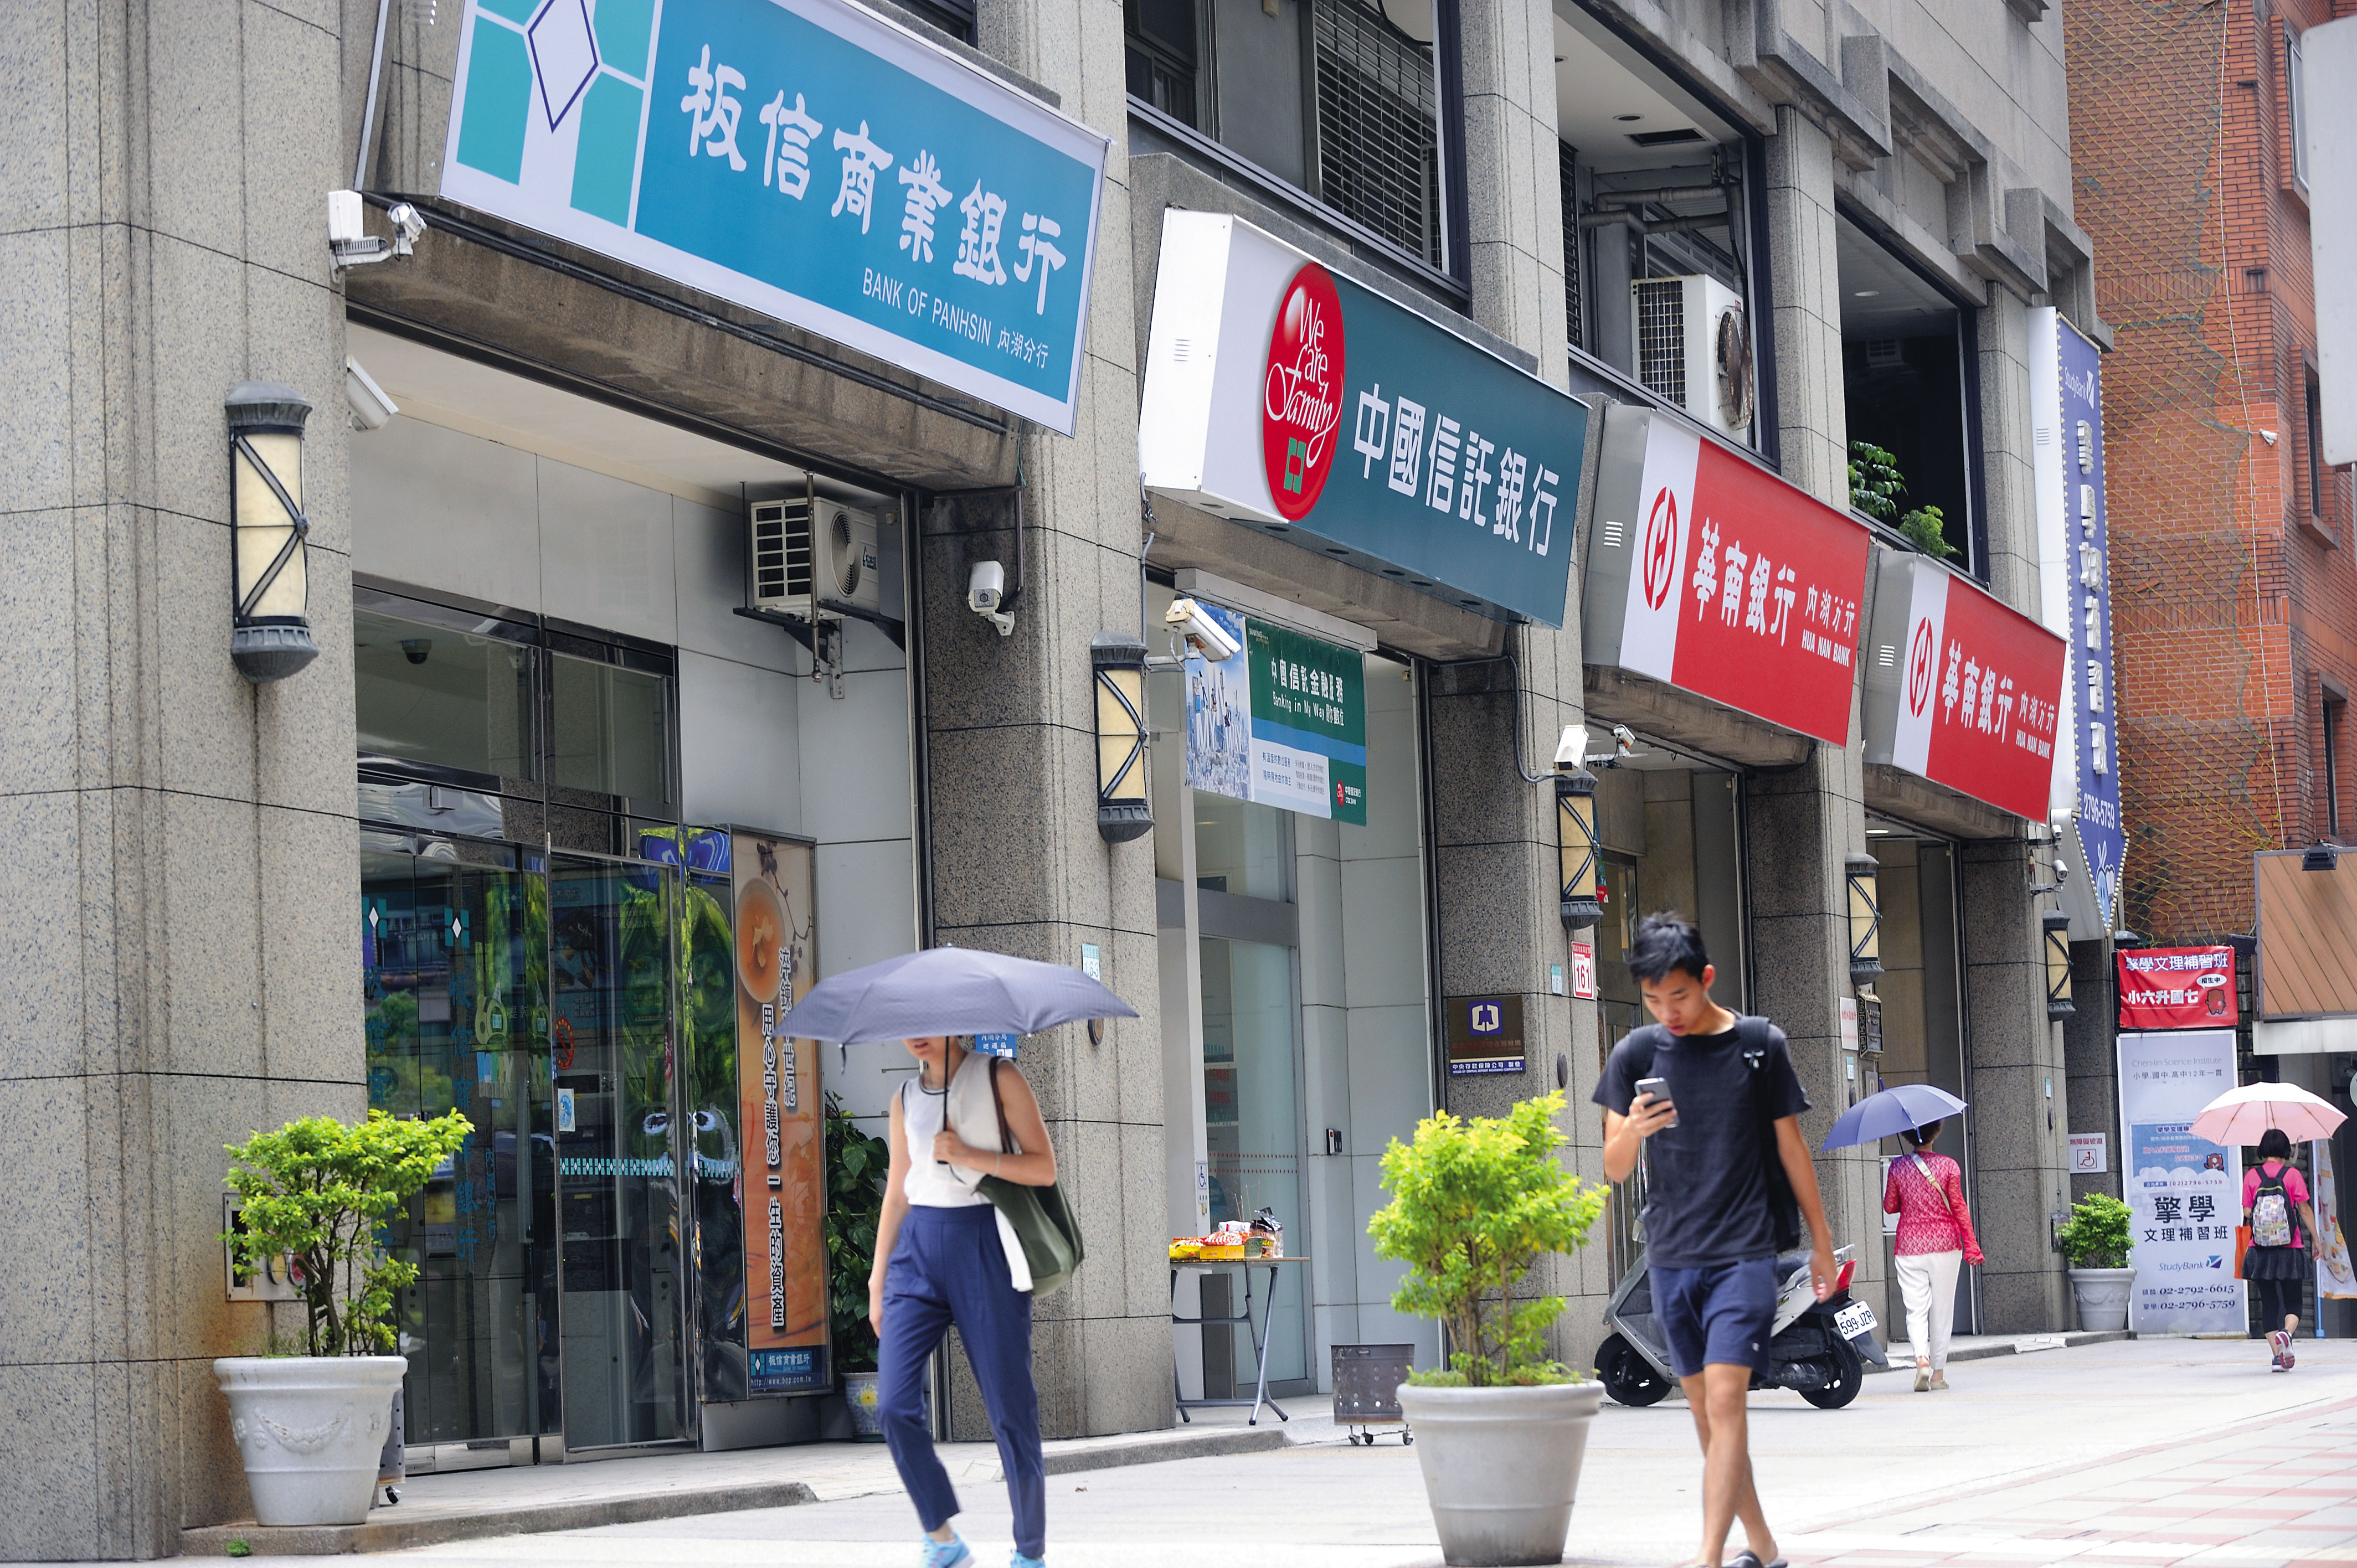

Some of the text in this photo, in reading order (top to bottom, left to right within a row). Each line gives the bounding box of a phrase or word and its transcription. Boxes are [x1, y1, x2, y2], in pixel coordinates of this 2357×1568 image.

[681, 43, 1067, 314] 板信商業銀行
[863, 267, 992, 347] BANK OF PANHSIN
[1299, 297, 1324, 350] We
[998, 327, 1048, 369] 內湖分行
[1304, 348, 1328, 385] are
[2065, 367, 2087, 401] StudyBank
[1354, 383, 1560, 556] 中國信託銀行
[1693, 517, 1796, 647] 華南銀行
[1805, 583, 1855, 639] 內湖分行
[1802, 630, 1850, 668] HUA NAN BANK
[1271, 657, 1344, 704] 中國信託金融服務
[1942, 639, 2013, 744] 華南銀行
[1273, 691, 1291, 713] Banking
[1294, 698, 1301, 713] in
[1304, 699, 1311, 718] My
[1313, 703, 1324, 721] Way
[2018, 690, 2055, 736] 內湖分行
[2015, 729, 2050, 760] HUA NAN BANK
[2083, 792, 2116, 831] 2796-5759
[1576, 964, 1591, 990] 161
[2126, 952, 2229, 973] 擎學文理補習班
[2128, 989, 2199, 1005] 小六升國七
[1452, 1062, 1504, 1070] 中央存款保險公司
[2164, 1058, 2191, 1067] Science
[2193, 1057, 2222, 1066] Institute
[2154, 1195, 2215, 1224] 擎學
[2144, 1225, 2229, 1242] 文理補習班
[2158, 1261, 2204, 1272] StudyBank
[2160, 1283, 2235, 1296] 02-2792-6615
[2161, 1299, 2236, 1310] 02-2796-5759
[1840, 1311, 1875, 1335] 599-JZR
[750, 1375, 812, 1388] http://www.bop.com.tw
